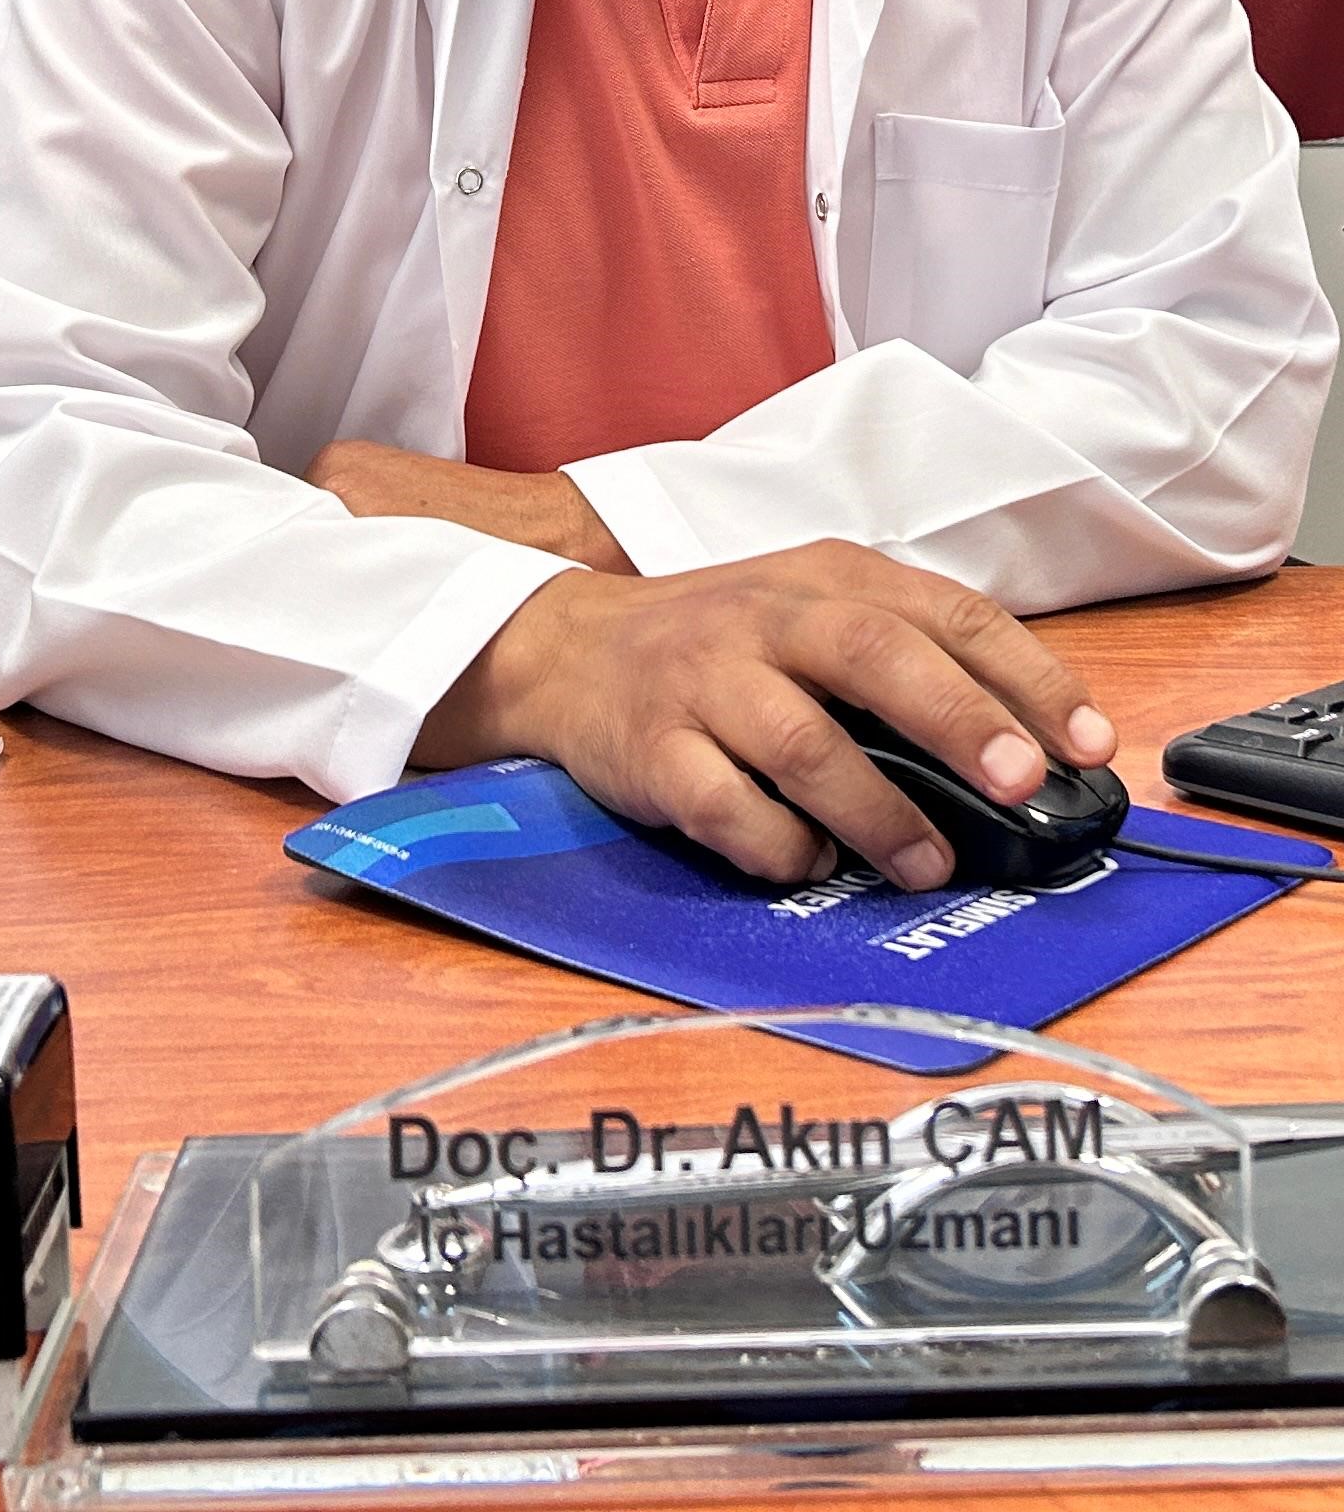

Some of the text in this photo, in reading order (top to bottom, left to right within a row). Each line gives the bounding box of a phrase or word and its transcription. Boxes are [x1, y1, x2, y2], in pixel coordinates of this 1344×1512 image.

[388, 1096, 1105, 1190] Doç. Dr. Akın ÇAM
[492, 1199, 829, 1262] Hastalıkları
[854, 1197, 1080, 1252] Uzmanı
